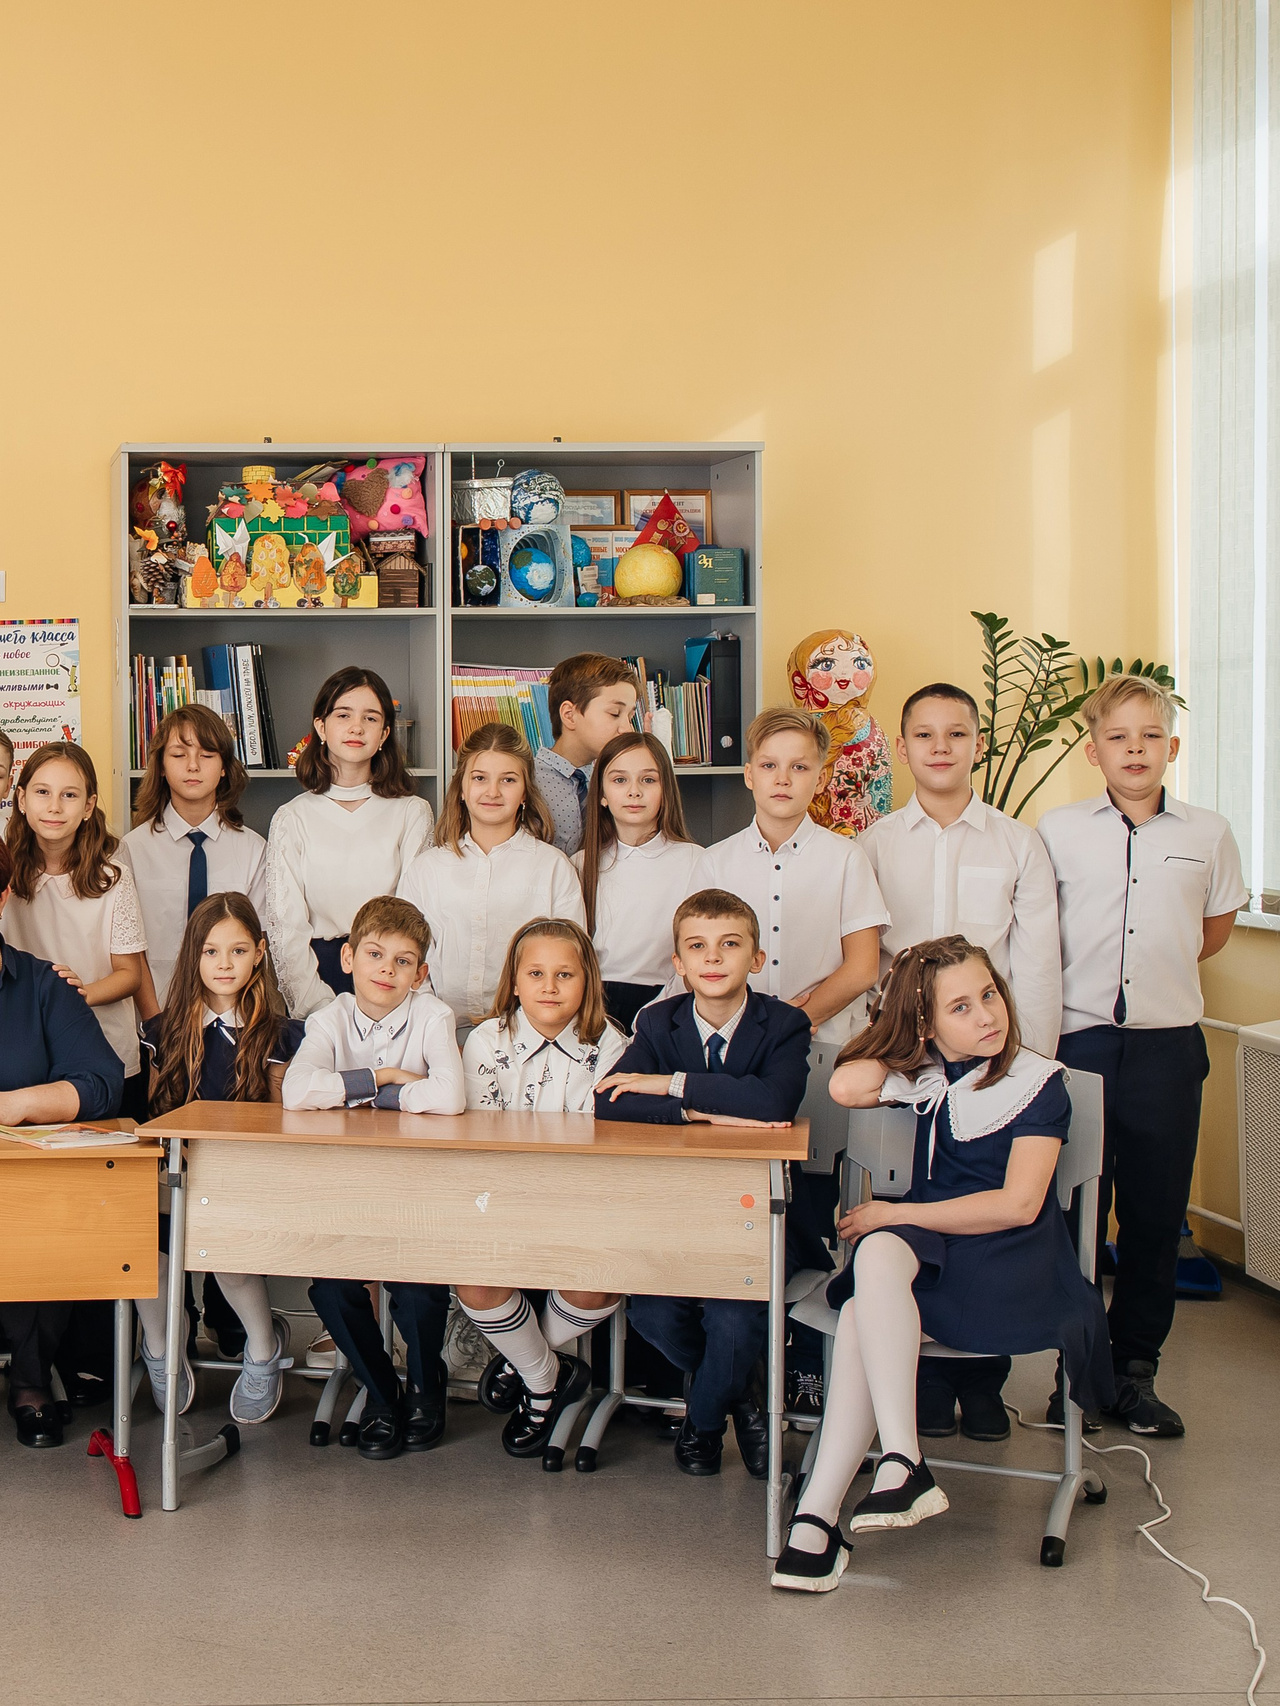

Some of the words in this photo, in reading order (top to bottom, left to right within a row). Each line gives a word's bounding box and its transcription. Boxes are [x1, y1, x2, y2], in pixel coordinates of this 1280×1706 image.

[31, 630, 77, 643] класса
[2, 649, 32, 660] новое
[0, 668, 61, 677] НЕИЗВЕДАННОЕ
[241, 658, 250, 677] ТРАВЕ
[243, 678, 250, 687] НА
[2, 699, 66, 712] окружающих
[243, 688, 253, 712] ХОККЕЙ
